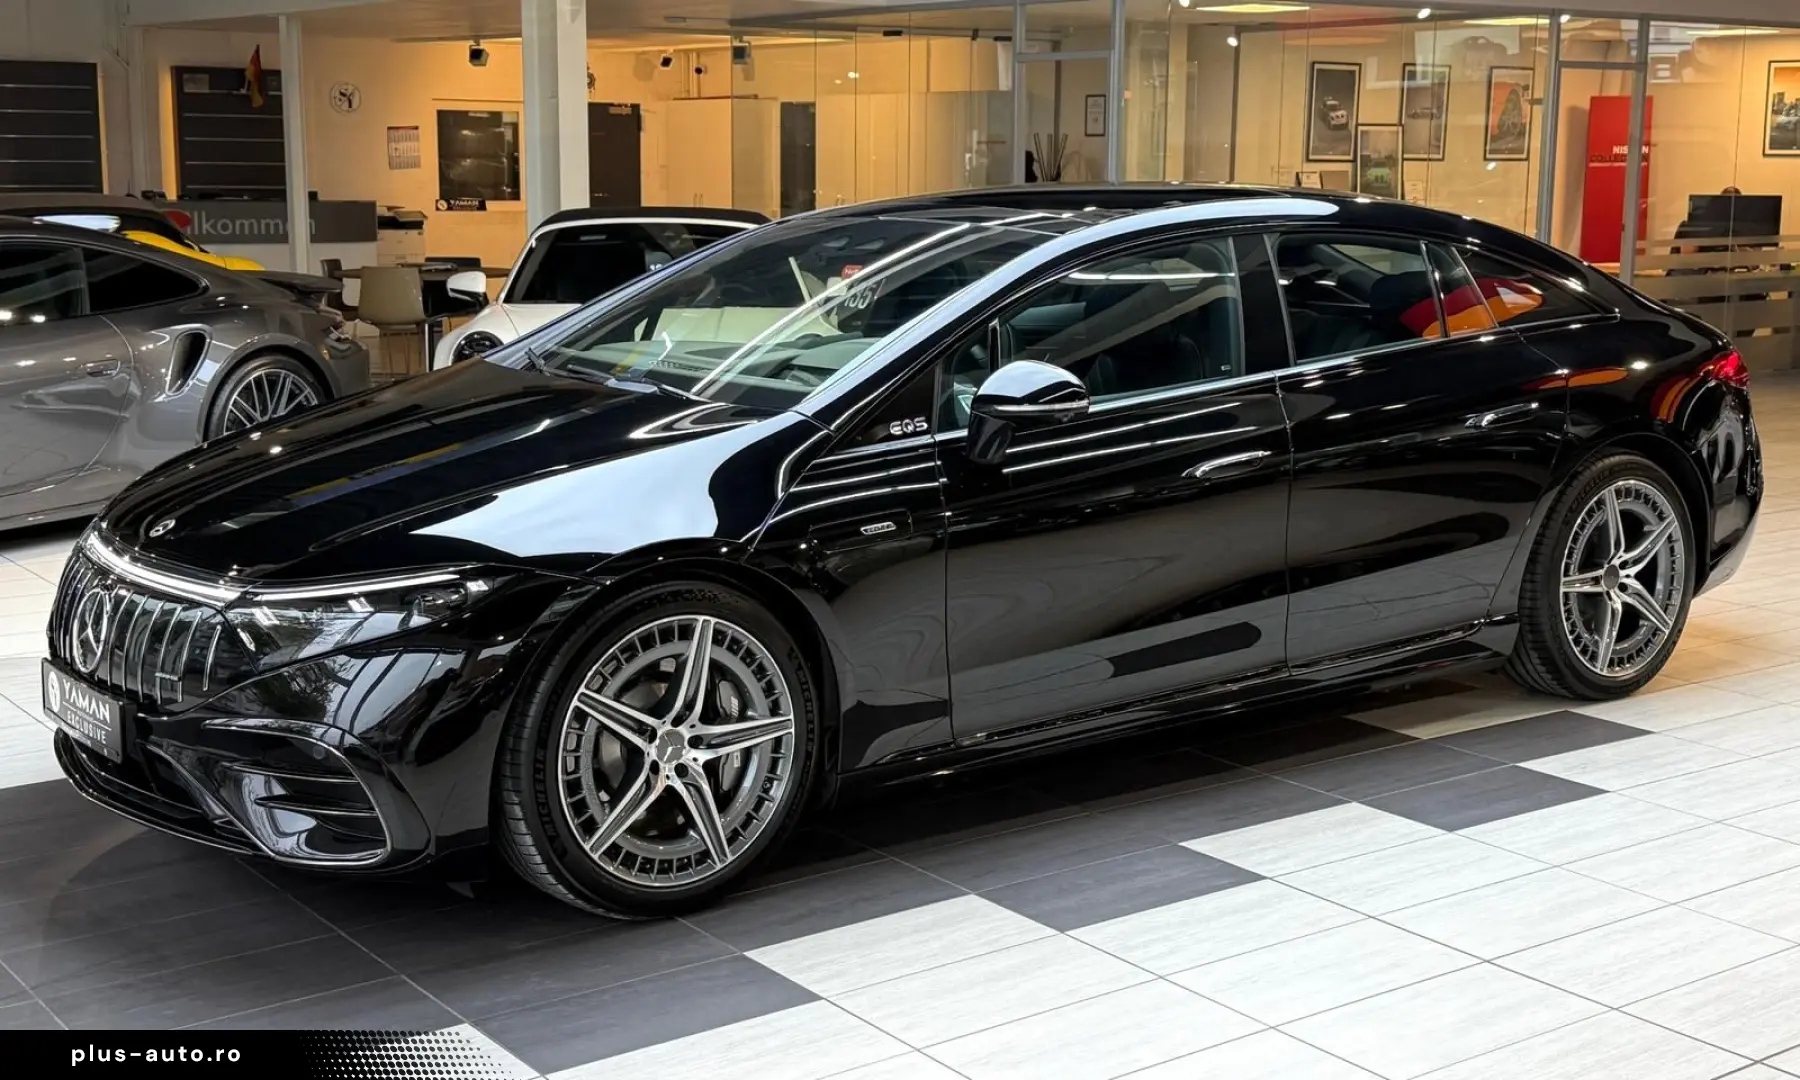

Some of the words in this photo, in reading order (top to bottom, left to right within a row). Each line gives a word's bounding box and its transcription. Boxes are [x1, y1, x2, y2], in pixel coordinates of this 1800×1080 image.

[1590, 154, 1648, 163] COLLECN
[1612, 145, 1649, 154] NISN
[889, 416, 928, 435] EQS
[62, 678, 110, 724] YAMAN
[67, 710, 107, 745] EXCLUSIVE
